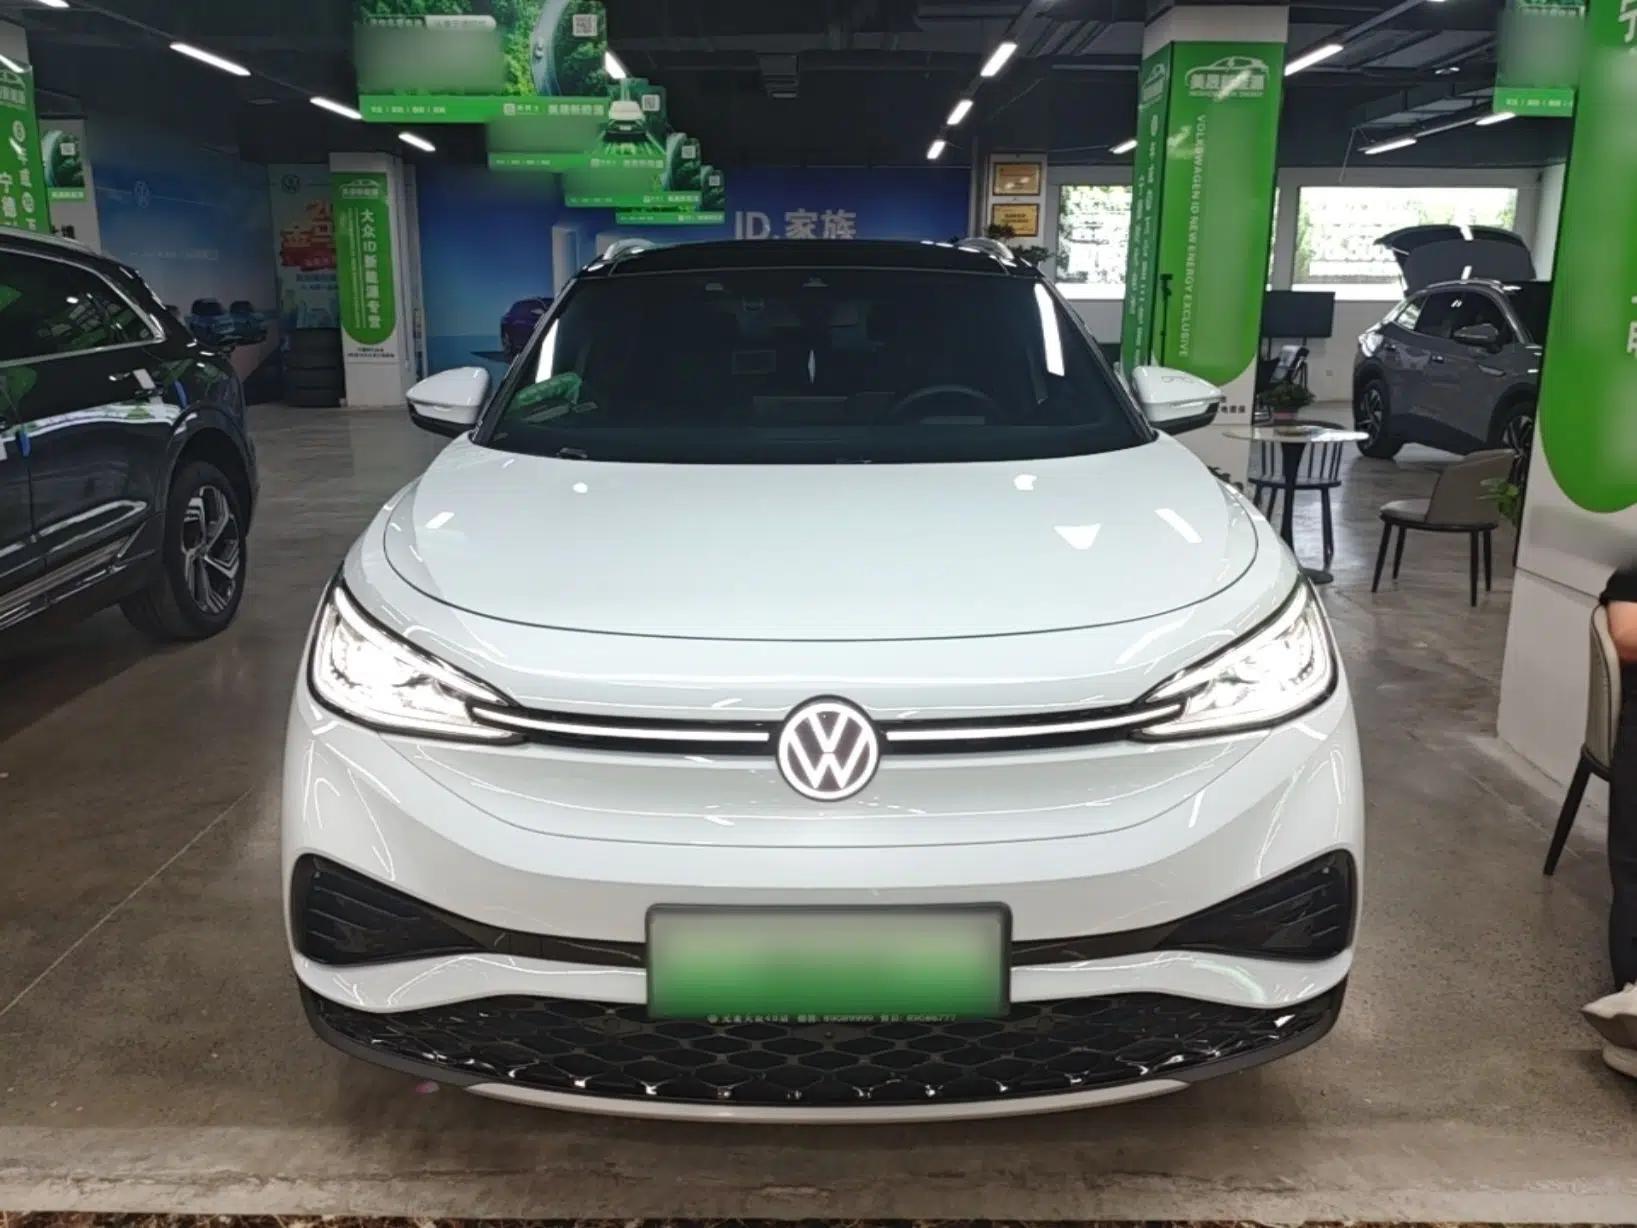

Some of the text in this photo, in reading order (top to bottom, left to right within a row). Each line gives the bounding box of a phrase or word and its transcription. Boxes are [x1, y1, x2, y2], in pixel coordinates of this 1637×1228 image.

[735, 208, 856, 240] ID.家族
[1178, 114, 1207, 357] VOLKSWAGEN ID NEW ENERGY EXCLUSIVE
